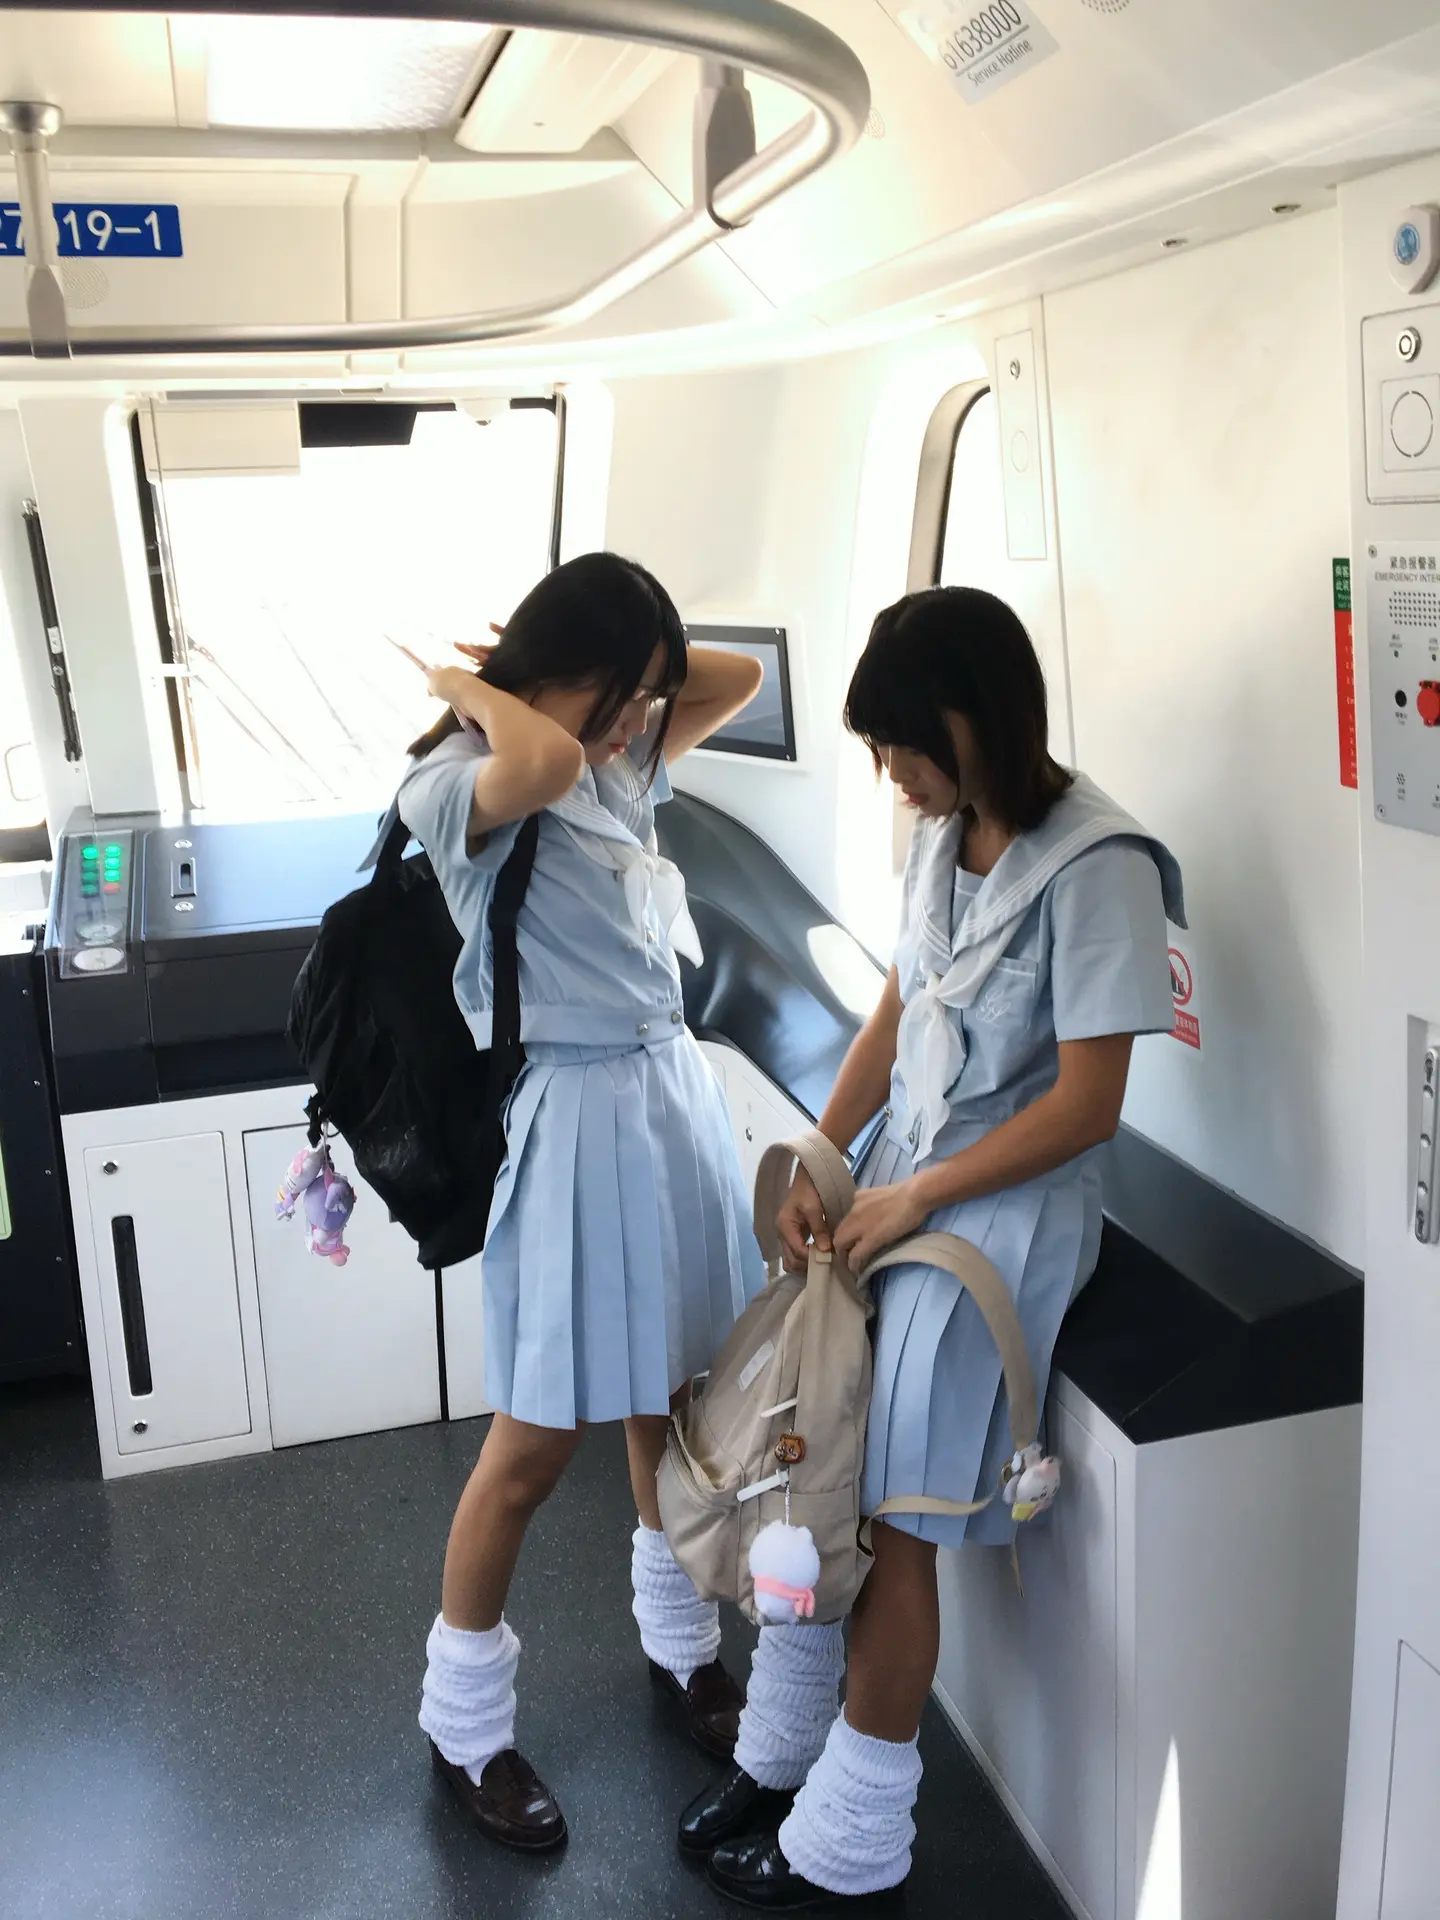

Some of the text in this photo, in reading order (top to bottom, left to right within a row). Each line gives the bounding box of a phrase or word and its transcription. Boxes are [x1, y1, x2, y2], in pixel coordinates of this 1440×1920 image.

[937, 0, 1022, 70] 61638000
[967, 39, 1033, 88] Service Hotline
[1374, 571, 1418, 582] EMERGENCY
